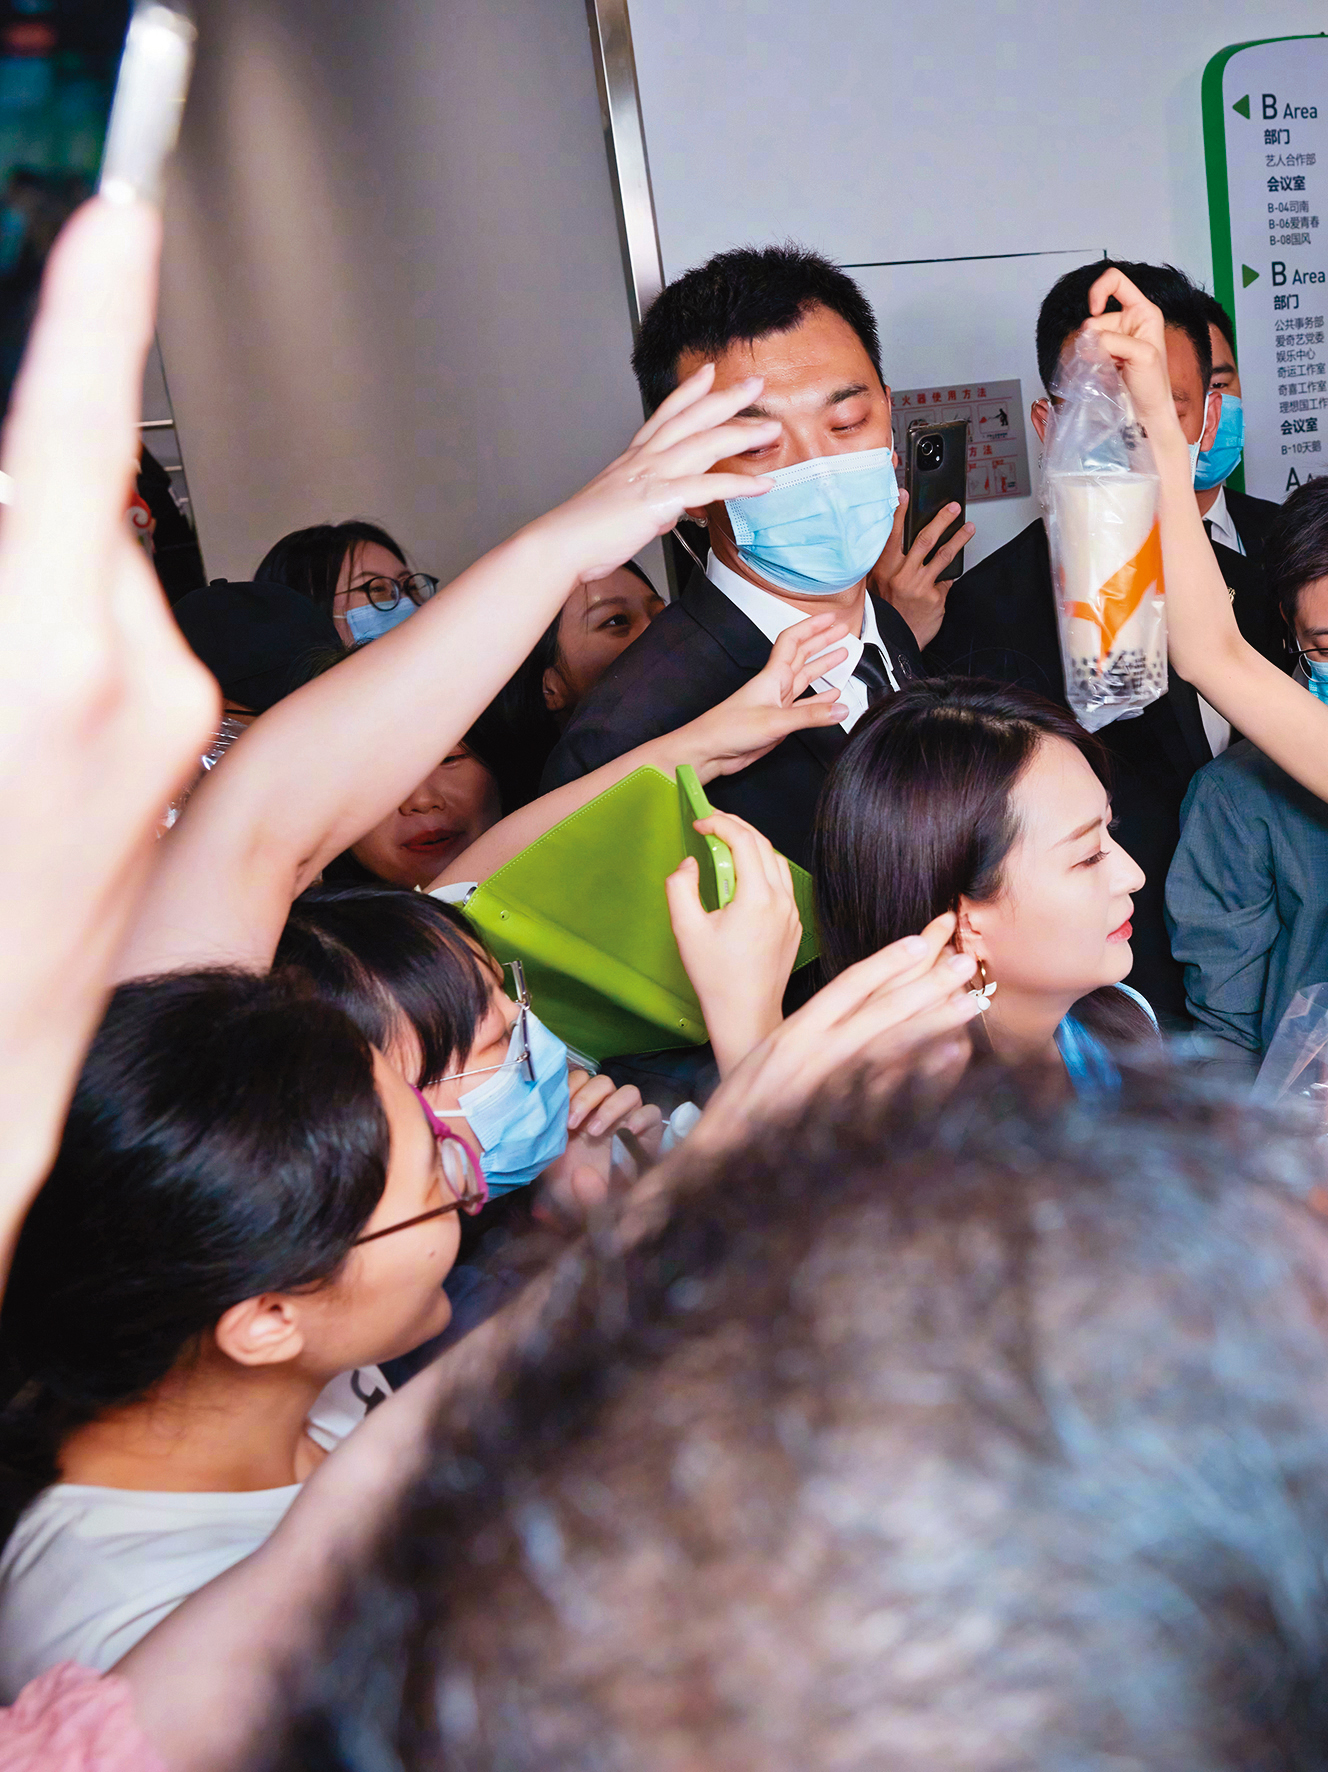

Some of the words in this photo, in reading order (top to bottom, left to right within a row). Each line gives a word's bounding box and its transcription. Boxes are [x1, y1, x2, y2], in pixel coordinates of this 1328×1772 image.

[1262, 93, 1278, 120] B
[1283, 102, 1318, 120] Area
[1264, 128, 1291, 145] 部门
[1265, 152, 1317, 168] 艺人合作部
[1267, 175, 1306, 192] 会议室
[1271, 261, 1287, 287] B
[1292, 268, 1326, 285] Area
[1273, 293, 1300, 311] 部门
[1274, 315, 1325, 332] 公共事务部
[1275, 331, 1325, 348] 爱奇艺党委
[1276, 347, 1316, 363] 娱乐中心
[1280, 417, 1318, 435] 会议室
